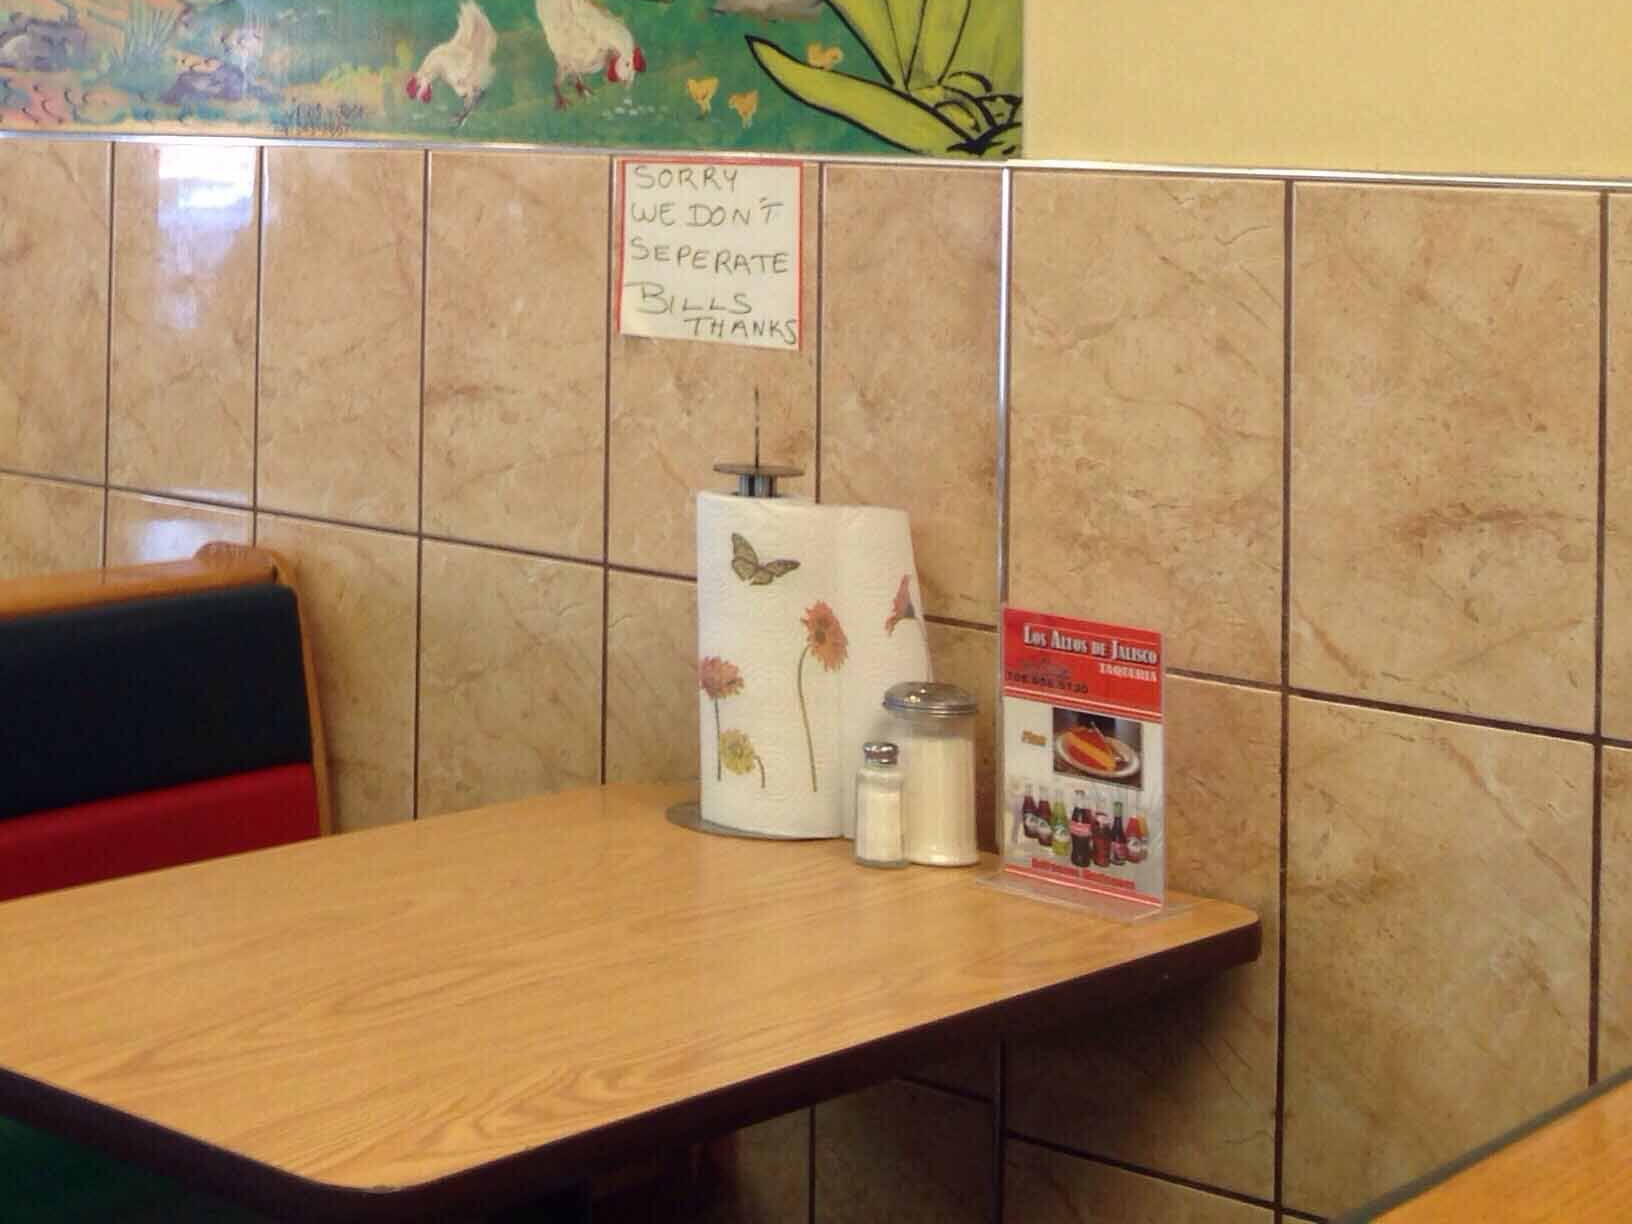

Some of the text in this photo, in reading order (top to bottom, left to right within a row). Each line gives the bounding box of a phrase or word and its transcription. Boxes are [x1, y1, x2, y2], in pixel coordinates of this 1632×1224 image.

[633, 165, 739, 192] SORRY
[630, 197, 784, 227] WE DON'T
[631, 237, 789, 276] SEPERATE
[624, 282, 753, 315] BILLS
[684, 317, 798, 345] THANKS
[1098, 663, 1158, 682] TAQUERIA
